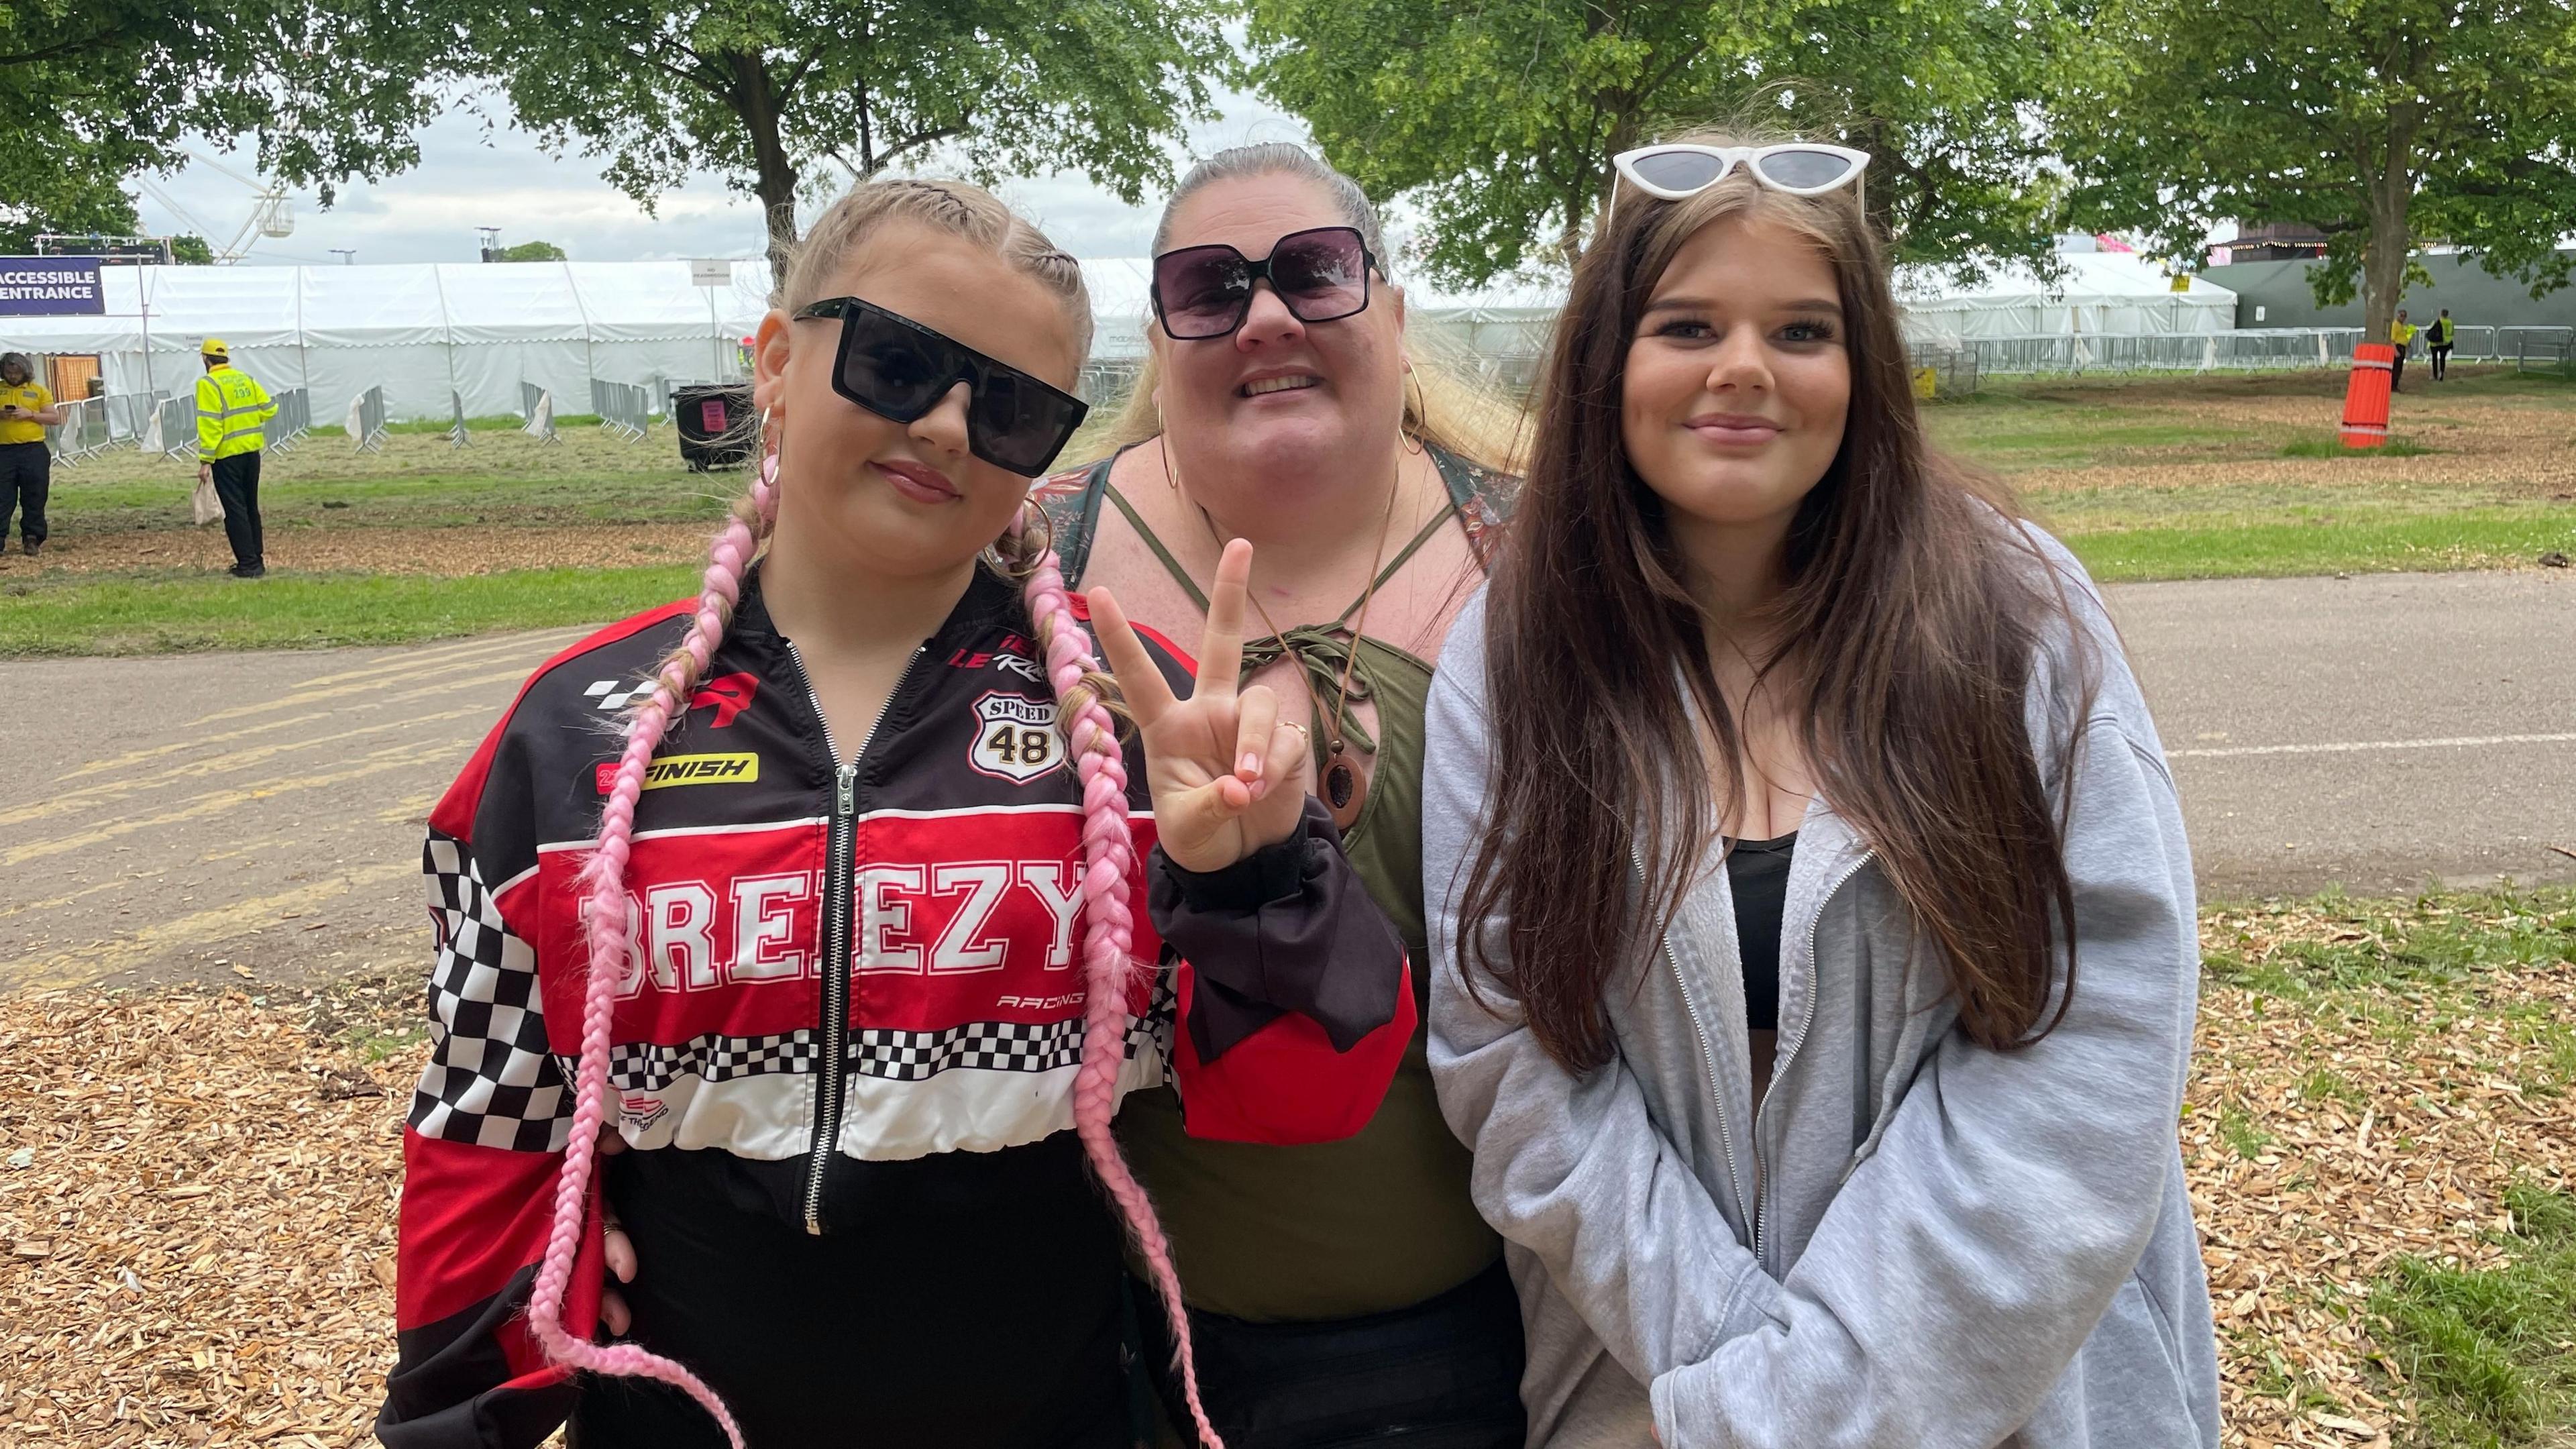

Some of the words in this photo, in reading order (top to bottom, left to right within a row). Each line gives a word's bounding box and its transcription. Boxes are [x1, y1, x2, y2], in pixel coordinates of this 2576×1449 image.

[0, 286, 93, 300] ENTRANCE
[989, 700, 1050, 720] SPEED
[987, 724, 1050, 766] 48
